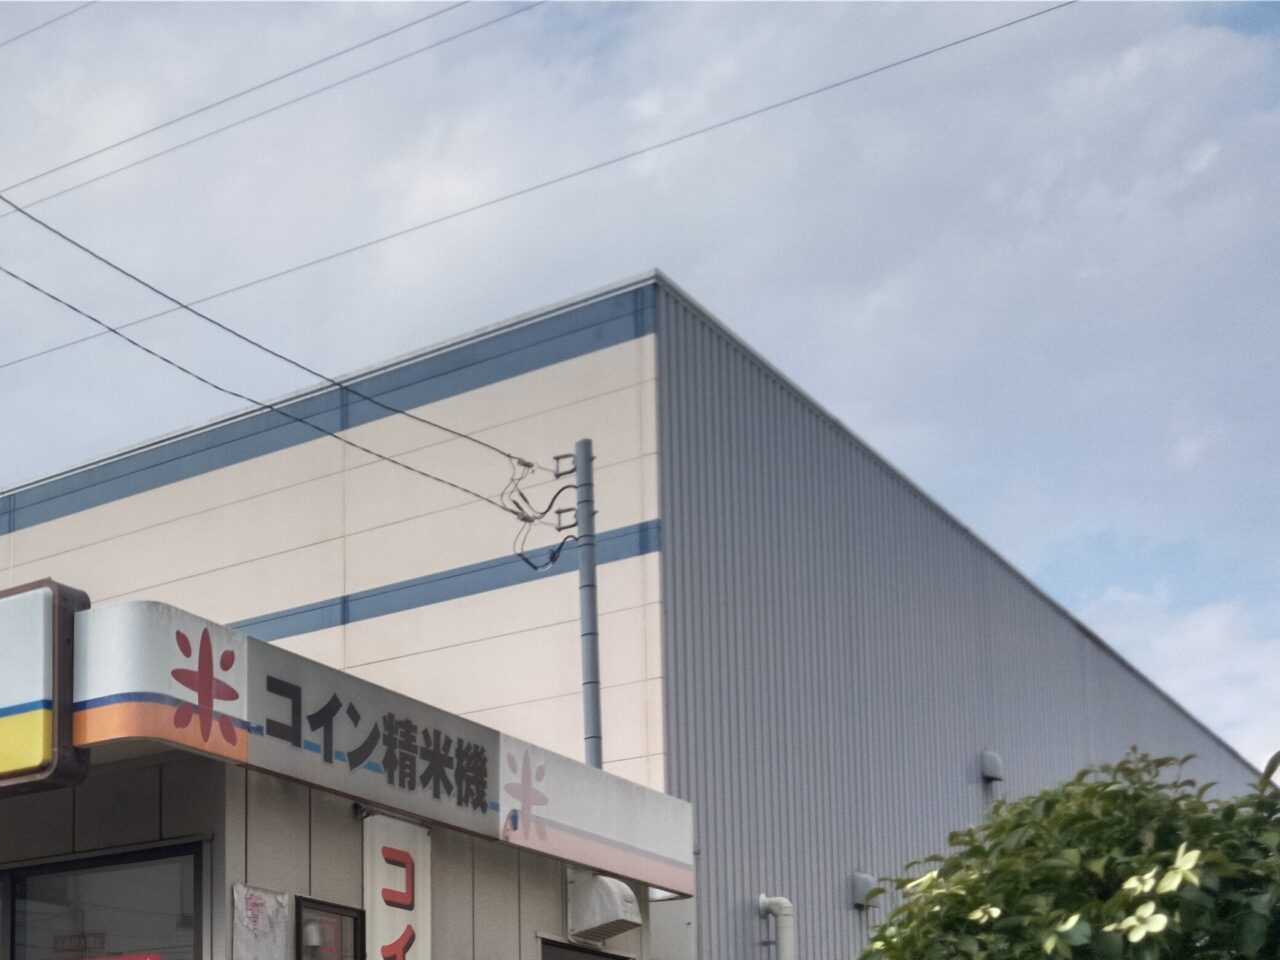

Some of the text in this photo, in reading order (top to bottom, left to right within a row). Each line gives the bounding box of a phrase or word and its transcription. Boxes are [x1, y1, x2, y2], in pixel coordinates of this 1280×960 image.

[266, 674, 489, 814] コイン精米機
